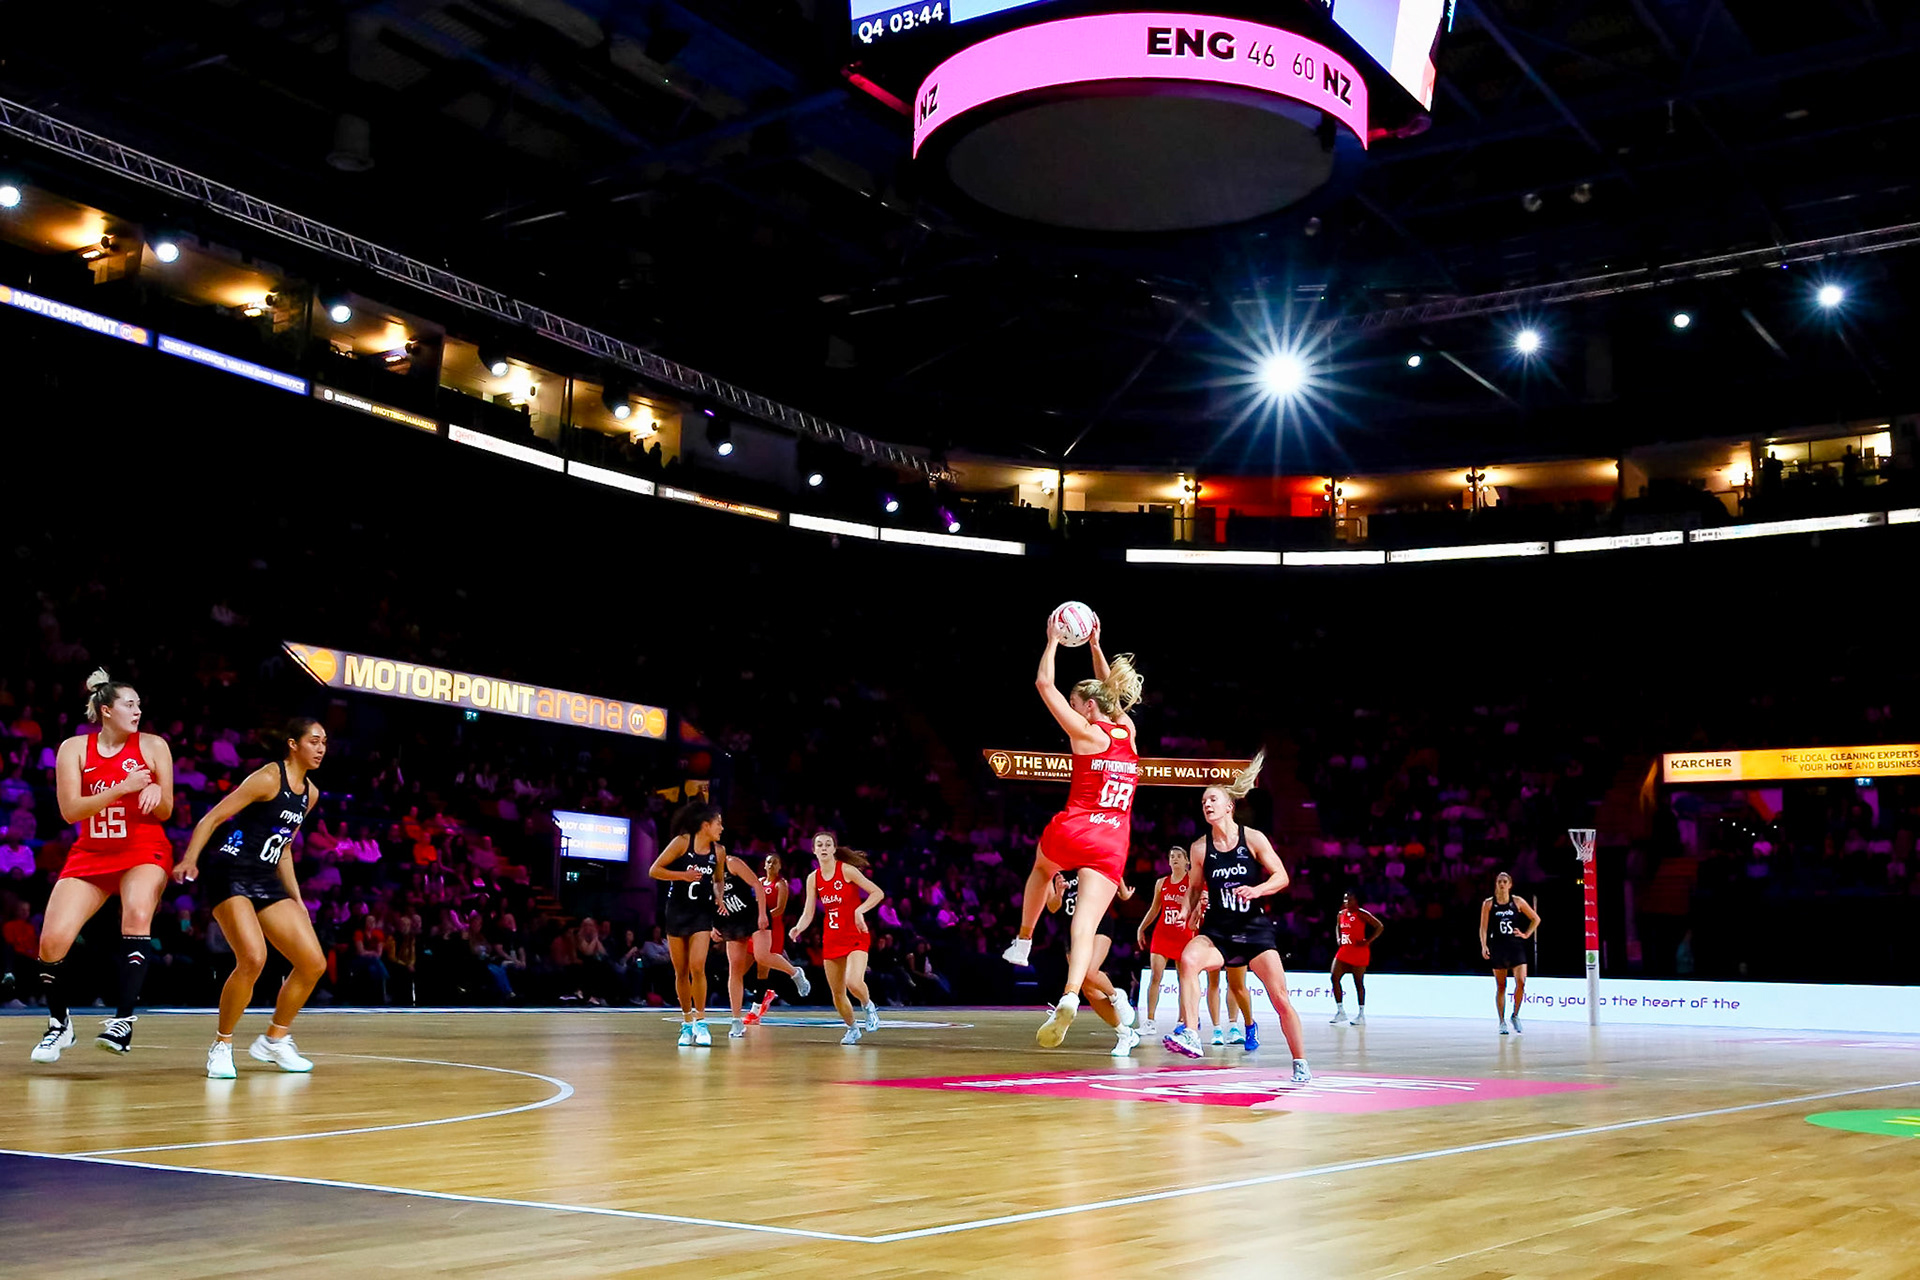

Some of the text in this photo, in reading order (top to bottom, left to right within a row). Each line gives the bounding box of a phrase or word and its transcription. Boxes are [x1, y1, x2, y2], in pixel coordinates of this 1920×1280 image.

[858, 2, 944, 43] Q4 03:44
[1147, 27, 1352, 106] ENG 46 60 NZ
[920, 83, 939, 128] NZ
[14, 291, 118, 334] MOTORPOINT
[344, 654, 624, 729] MOTORPOINT arena
[1013, 755, 1230, 779] THE WAL THE WALTON
[1781, 750, 1919, 763] THE LOCAL CLEANING EXPERTS
[1799, 763, 1824, 772] YOUR
[1826, 762, 1853, 771] HOME
[1855, 761, 1875, 770] AND
[1098, 780, 1135, 812] GA
[89, 806, 127, 839] GS
[280, 809, 304, 824] myob
[1212, 863, 1247, 879] myob
[688, 881, 701, 900] C
[1499, 920, 1514, 935] GS
[1306, 987, 1320, 997] of
[1507, 993, 1554, 1007] Tking
[1559, 995, 1586, 1008] you
[1612, 995, 1638, 1007] the
[1642, 996, 1685, 1008] heart
[1691, 997, 1708, 1008] of
[1713, 998, 1740, 1010] the
